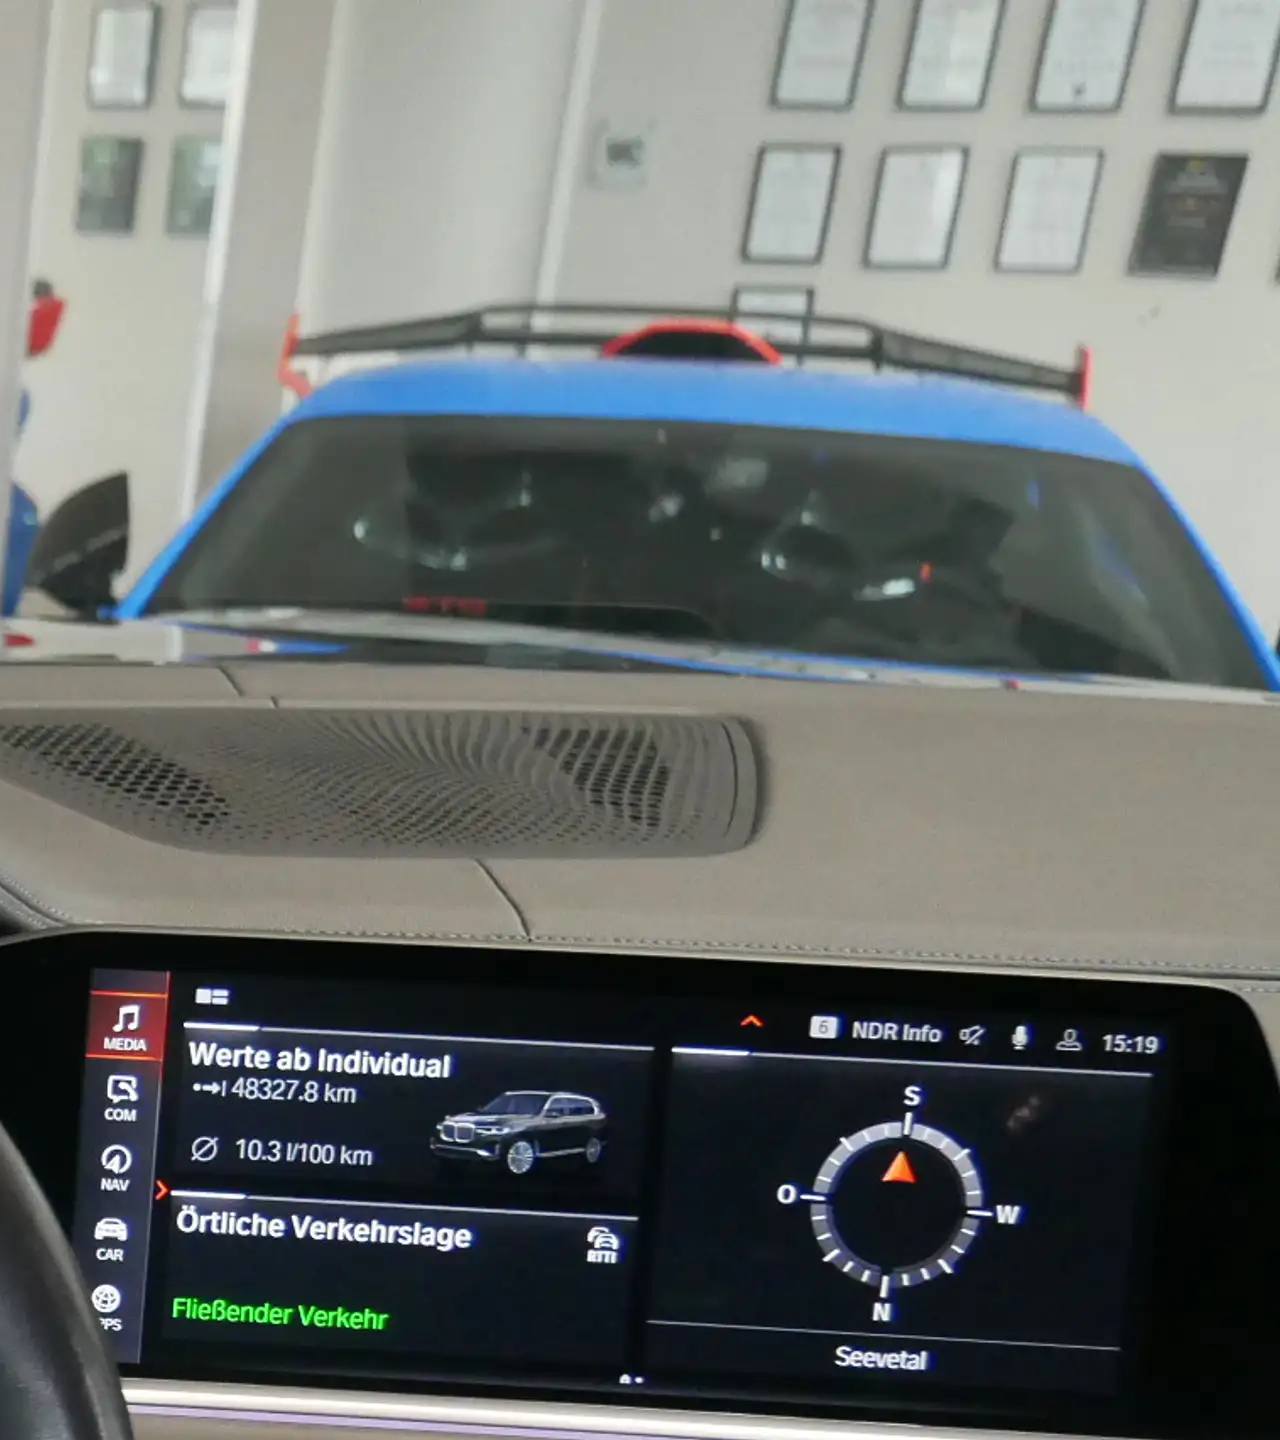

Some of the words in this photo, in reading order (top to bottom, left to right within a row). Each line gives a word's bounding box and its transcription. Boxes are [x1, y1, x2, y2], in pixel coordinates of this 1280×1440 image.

[103, 1037, 148, 1052] MEDIA
[851, 1021, 899, 1041] NDR
[902, 1023, 942, 1043] Info
[1102, 1034, 1159, 1054] 15:19
[188, 1041, 272, 1070] Werte
[276, 1045, 311, 1072] ab
[317, 1046, 451, 1078] Individual
[231, 1078, 319, 1102] 48327.8
[324, 1080, 357, 1104] km
[903, 1085, 922, 1106] S
[104, 1107, 137, 1122] COM
[235, 1139, 280, 1162] 10.3
[286, 1142, 334, 1165] l/100
[340, 1145, 373, 1167] km
[100, 1178, 130, 1192] NAV
[176, 1204, 286, 1239] Örtliche
[291, 1213, 473, 1250] Verkehrslage
[996, 1206, 1020, 1225] W
[95, 1248, 125, 1262] CAR
[171, 1297, 294, 1326] Fließender
[298, 1304, 391, 1331] Verkehr
[872, 1302, 892, 1322] N
[834, 1345, 928, 1371] Seevetal
